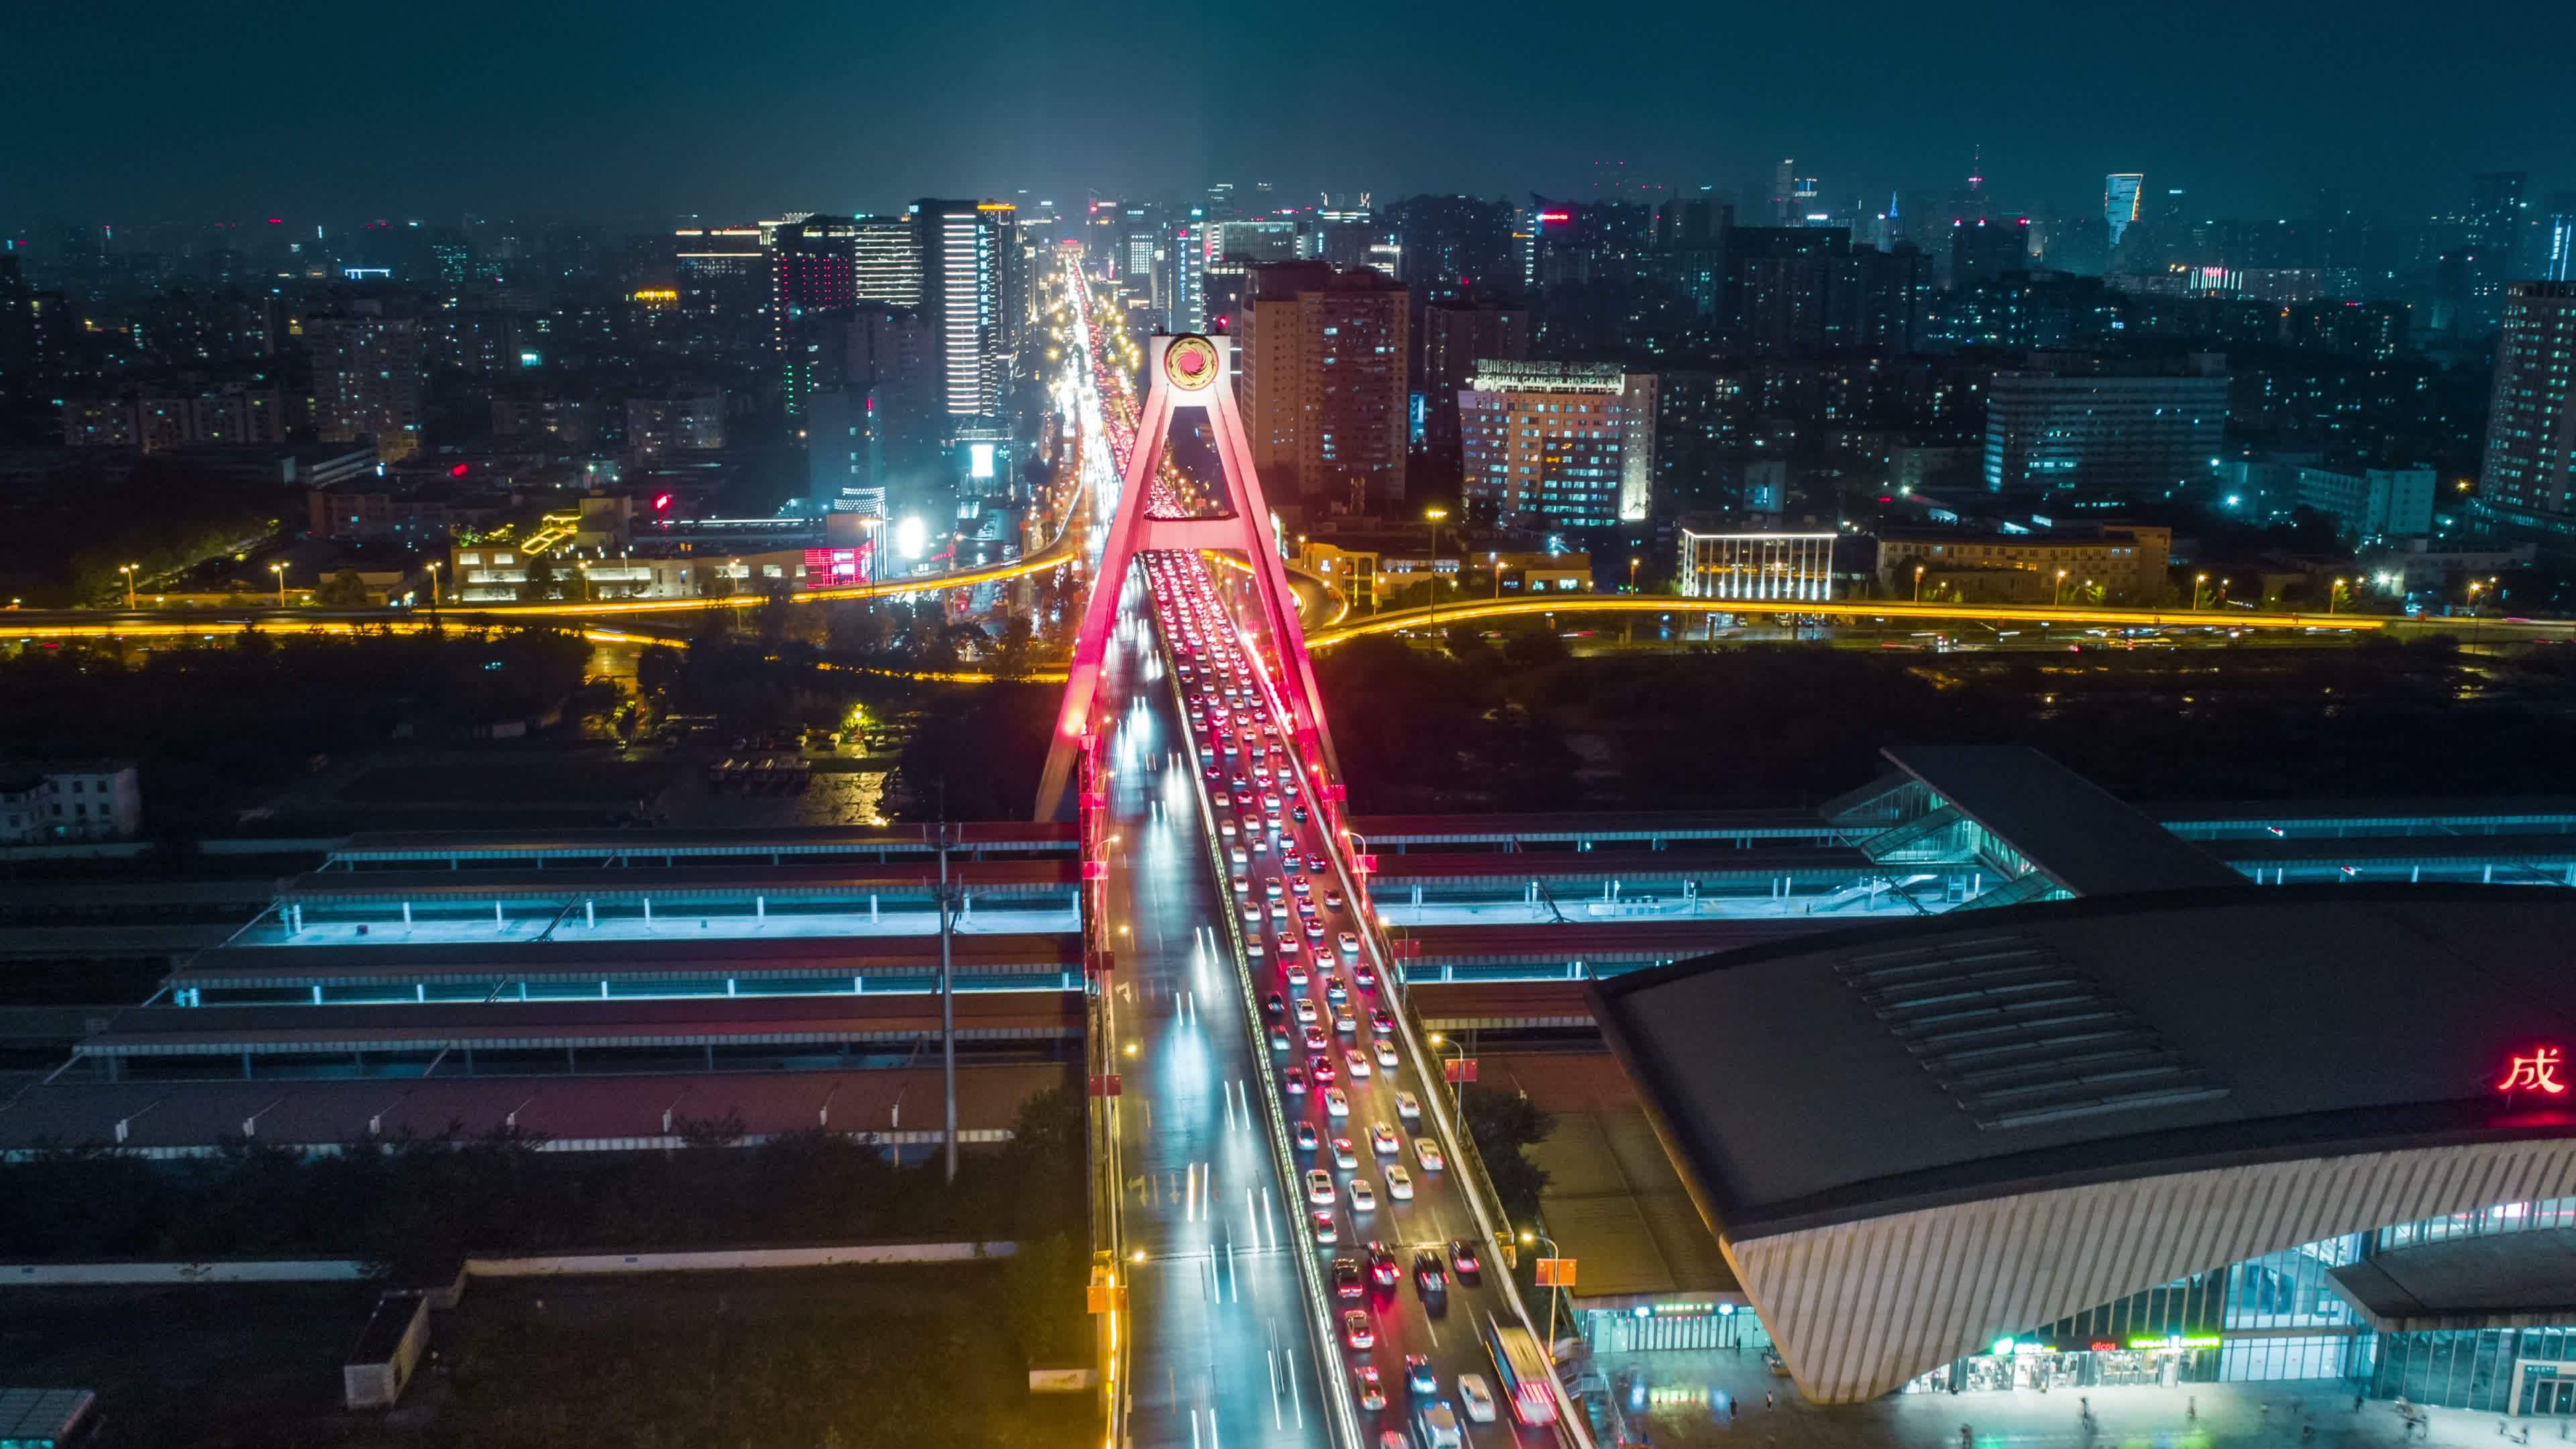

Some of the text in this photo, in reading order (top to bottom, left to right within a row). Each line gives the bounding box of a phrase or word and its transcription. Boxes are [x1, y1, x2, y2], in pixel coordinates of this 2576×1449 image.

[1477, 374, 1518, 383] SICHUAN
[1522, 375, 1563, 384] CANCER
[2498, 1048, 2565, 1093] 成
[2091, 1342, 2116, 1351] dicos
